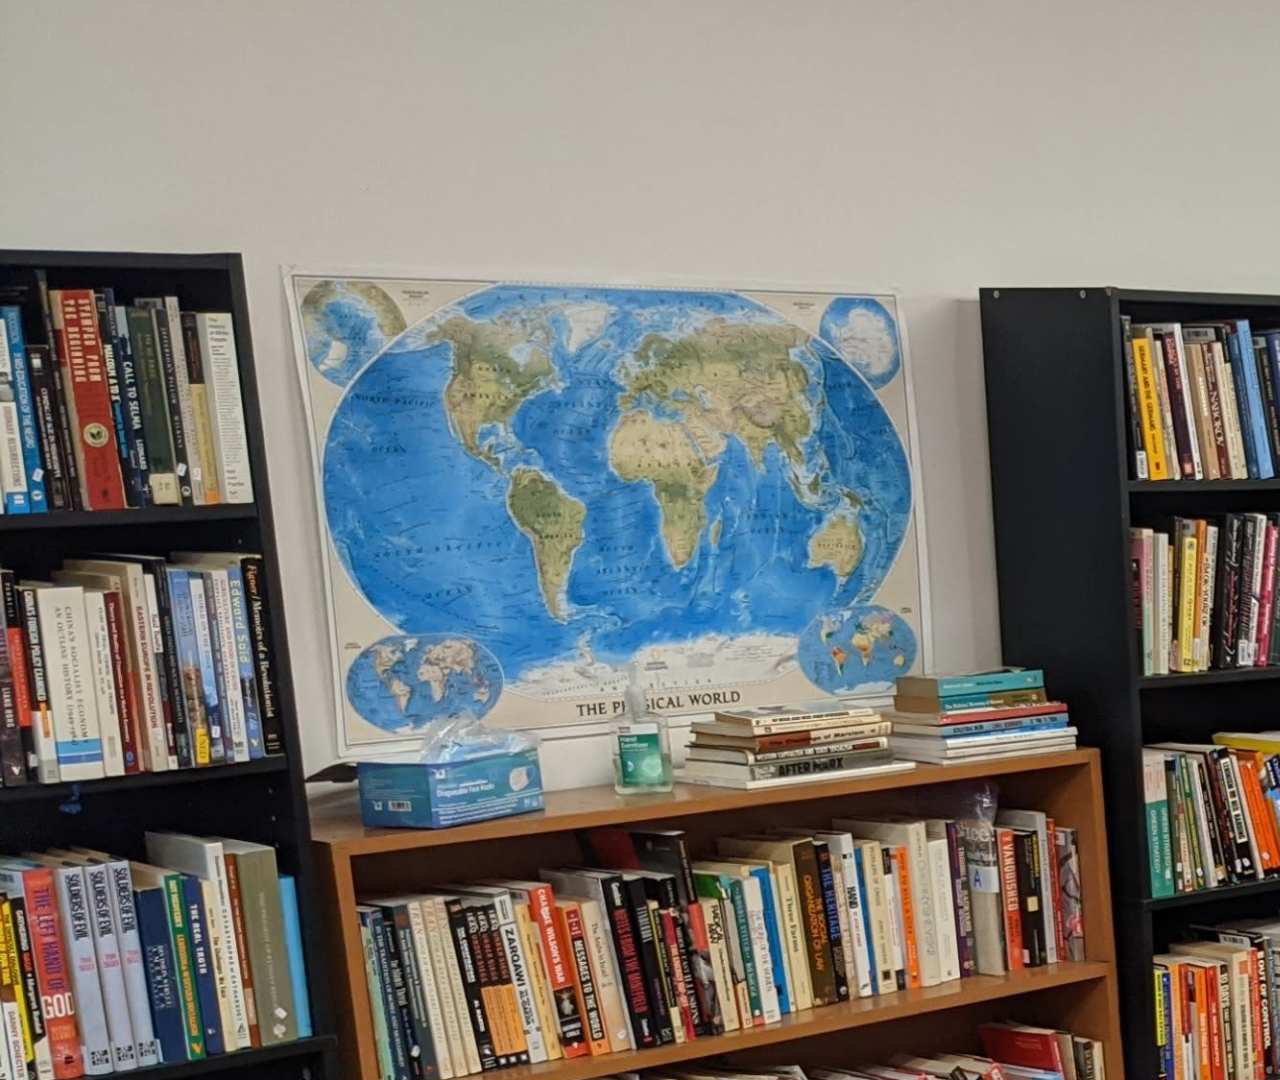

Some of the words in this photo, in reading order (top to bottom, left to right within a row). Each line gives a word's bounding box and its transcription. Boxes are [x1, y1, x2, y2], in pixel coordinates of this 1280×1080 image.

[67, 327, 86, 382] BEGINNING
[77, 299, 97, 346] STAMPED
[87, 355, 101, 382] FROM
[104, 344, 117, 377] MALCOLM
[123, 362, 136, 384] CALL
[127, 387, 136, 398] TO
[129, 401, 140, 430] SELMA
[1210, 391, 1225, 447] NABOKOV
[230, 580, 243, 630] Edward
[27, 617, 38, 644] FOREIGN
[136, 606, 148, 641] EASTERN
[252, 601, 264, 640] Memoirs
[56, 622, 67, 660] OUTLINE
[256, 641, 267, 653] of
[29, 645, 41, 667] POLICY
[140, 642, 152, 672] EUROPE
[60, 664, 72, 701] HISTORY
[70, 646, 83, 696] SOCIALIST
[259, 660, 275, 718] Revolutionist
[145, 682, 158, 729] REVOLUTION
[576, 701, 607, 716] THE
[613, 696, 685, 714] PSICAL
[688, 691, 741, 706] WORLD
[76, 699, 88, 744] ECONOMY
[778, 762, 809, 778] AFTER
[1152, 836, 1161, 873] STRATEGY
[89, 871, 109, 910] SOLDIERS
[113, 867, 131, 906] SOLDIERS
[1002, 843, 1017, 912] VANQUISHED
[33, 888, 53, 911] THE
[65, 874, 83, 913] SOLDIERS
[72, 913, 86, 923] OF
[97, 910, 110, 921] OF
[119, 905, 134, 916] OF
[189, 904, 198, 920] THE
[36, 914, 59, 938] LEFT
[74, 924, 89, 941] EVIL
[99, 921, 112, 938] EVIL
[122, 917, 136, 934] EVIL
[192, 923, 202, 944] REAL
[40, 942, 64, 976] HAND
[194, 947, 207, 974] TRUTH
[504, 928, 528, 987] ZARQAWI
[574, 940, 593, 981] MESSAGES
[1258, 960, 1266, 981] OUT
[47, 978, 68, 992] OF
[582, 983, 593, 993] TO
[1260, 983, 1266, 997] OF
[586, 994, 598, 1010] THE
[7, 1011, 18, 1039] DANNY
[588, 1011, 603, 1039] WORLD
[1262, 999, 1271, 1050] CONTROL
